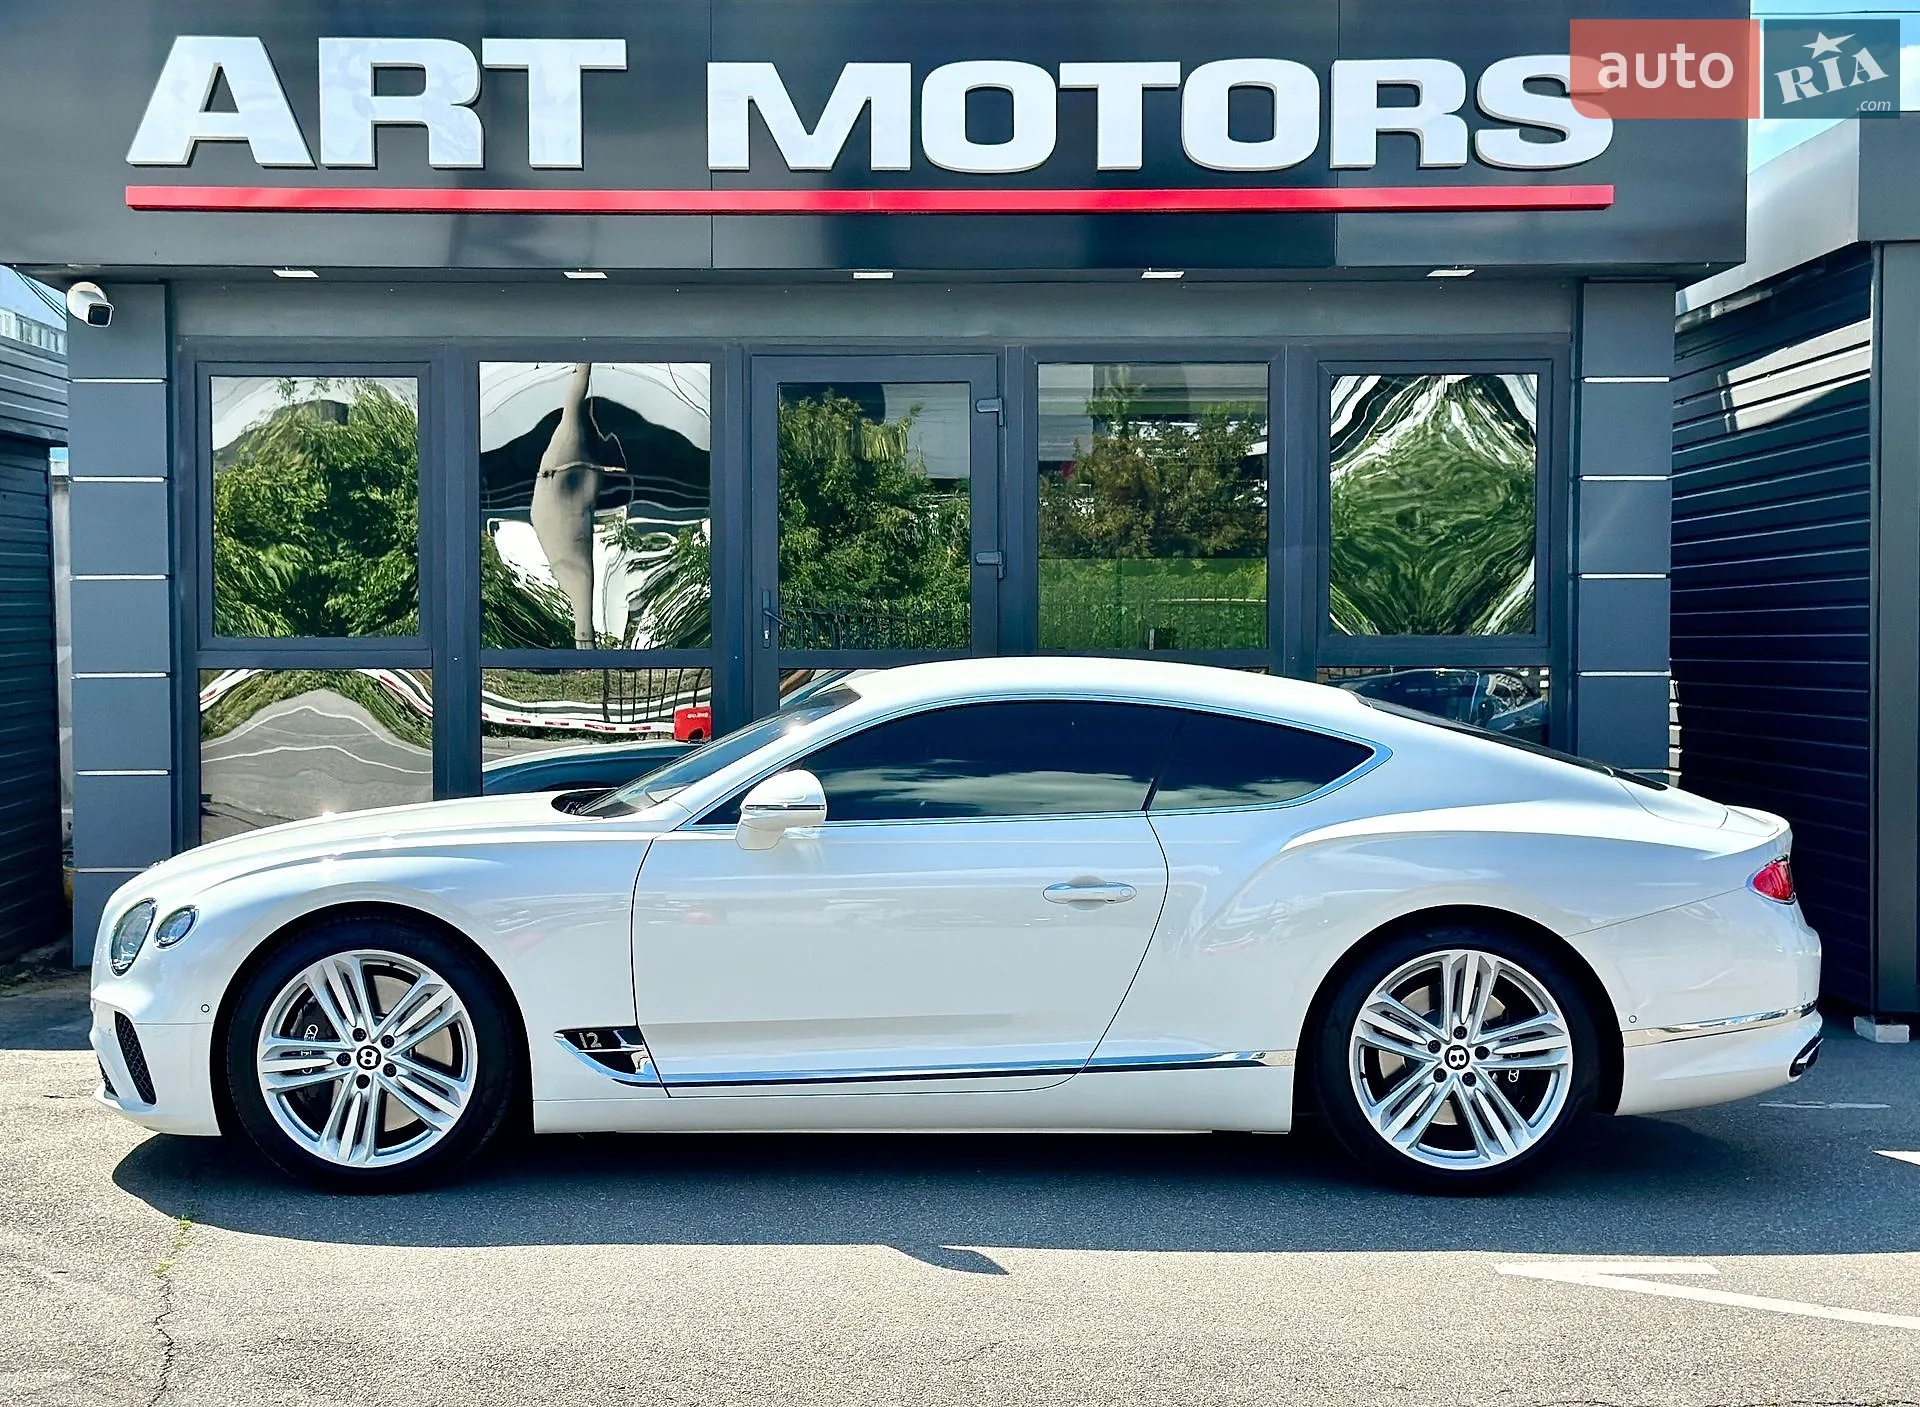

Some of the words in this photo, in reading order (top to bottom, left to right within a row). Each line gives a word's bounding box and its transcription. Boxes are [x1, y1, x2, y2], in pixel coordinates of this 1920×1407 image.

[125, 35, 628, 171] ART
[706, 55, 1614, 173] MOTORS
[578, 1032, 602, 1049] 12
